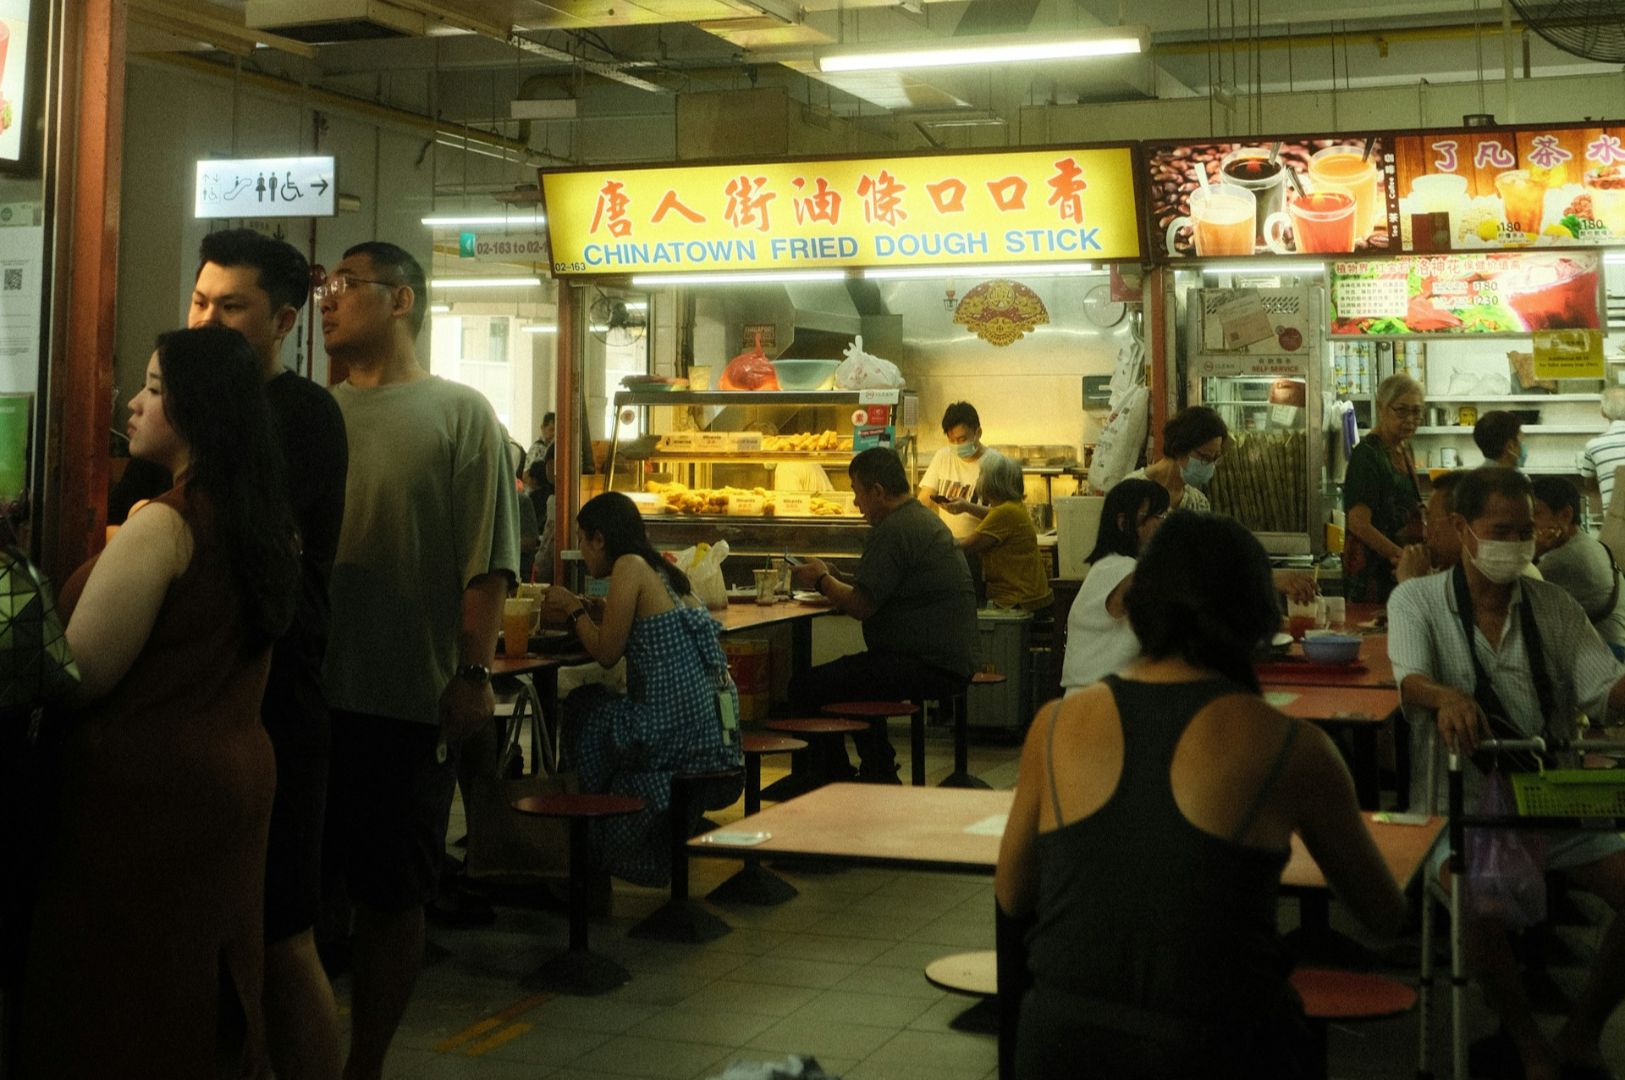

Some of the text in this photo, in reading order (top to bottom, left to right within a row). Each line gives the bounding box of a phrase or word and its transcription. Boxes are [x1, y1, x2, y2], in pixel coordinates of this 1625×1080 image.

[1433, 135, 1625, 171] 了凡茶水
[590, 158, 1088, 238] 唐人街油條口口香
[477, 241, 511, 255] 02-163
[513, 241, 526, 254] to
[584, 228, 1102, 266] CHINATOWN FRIED DOUGH STICK
[555, 262, 586, 271] 02-163
